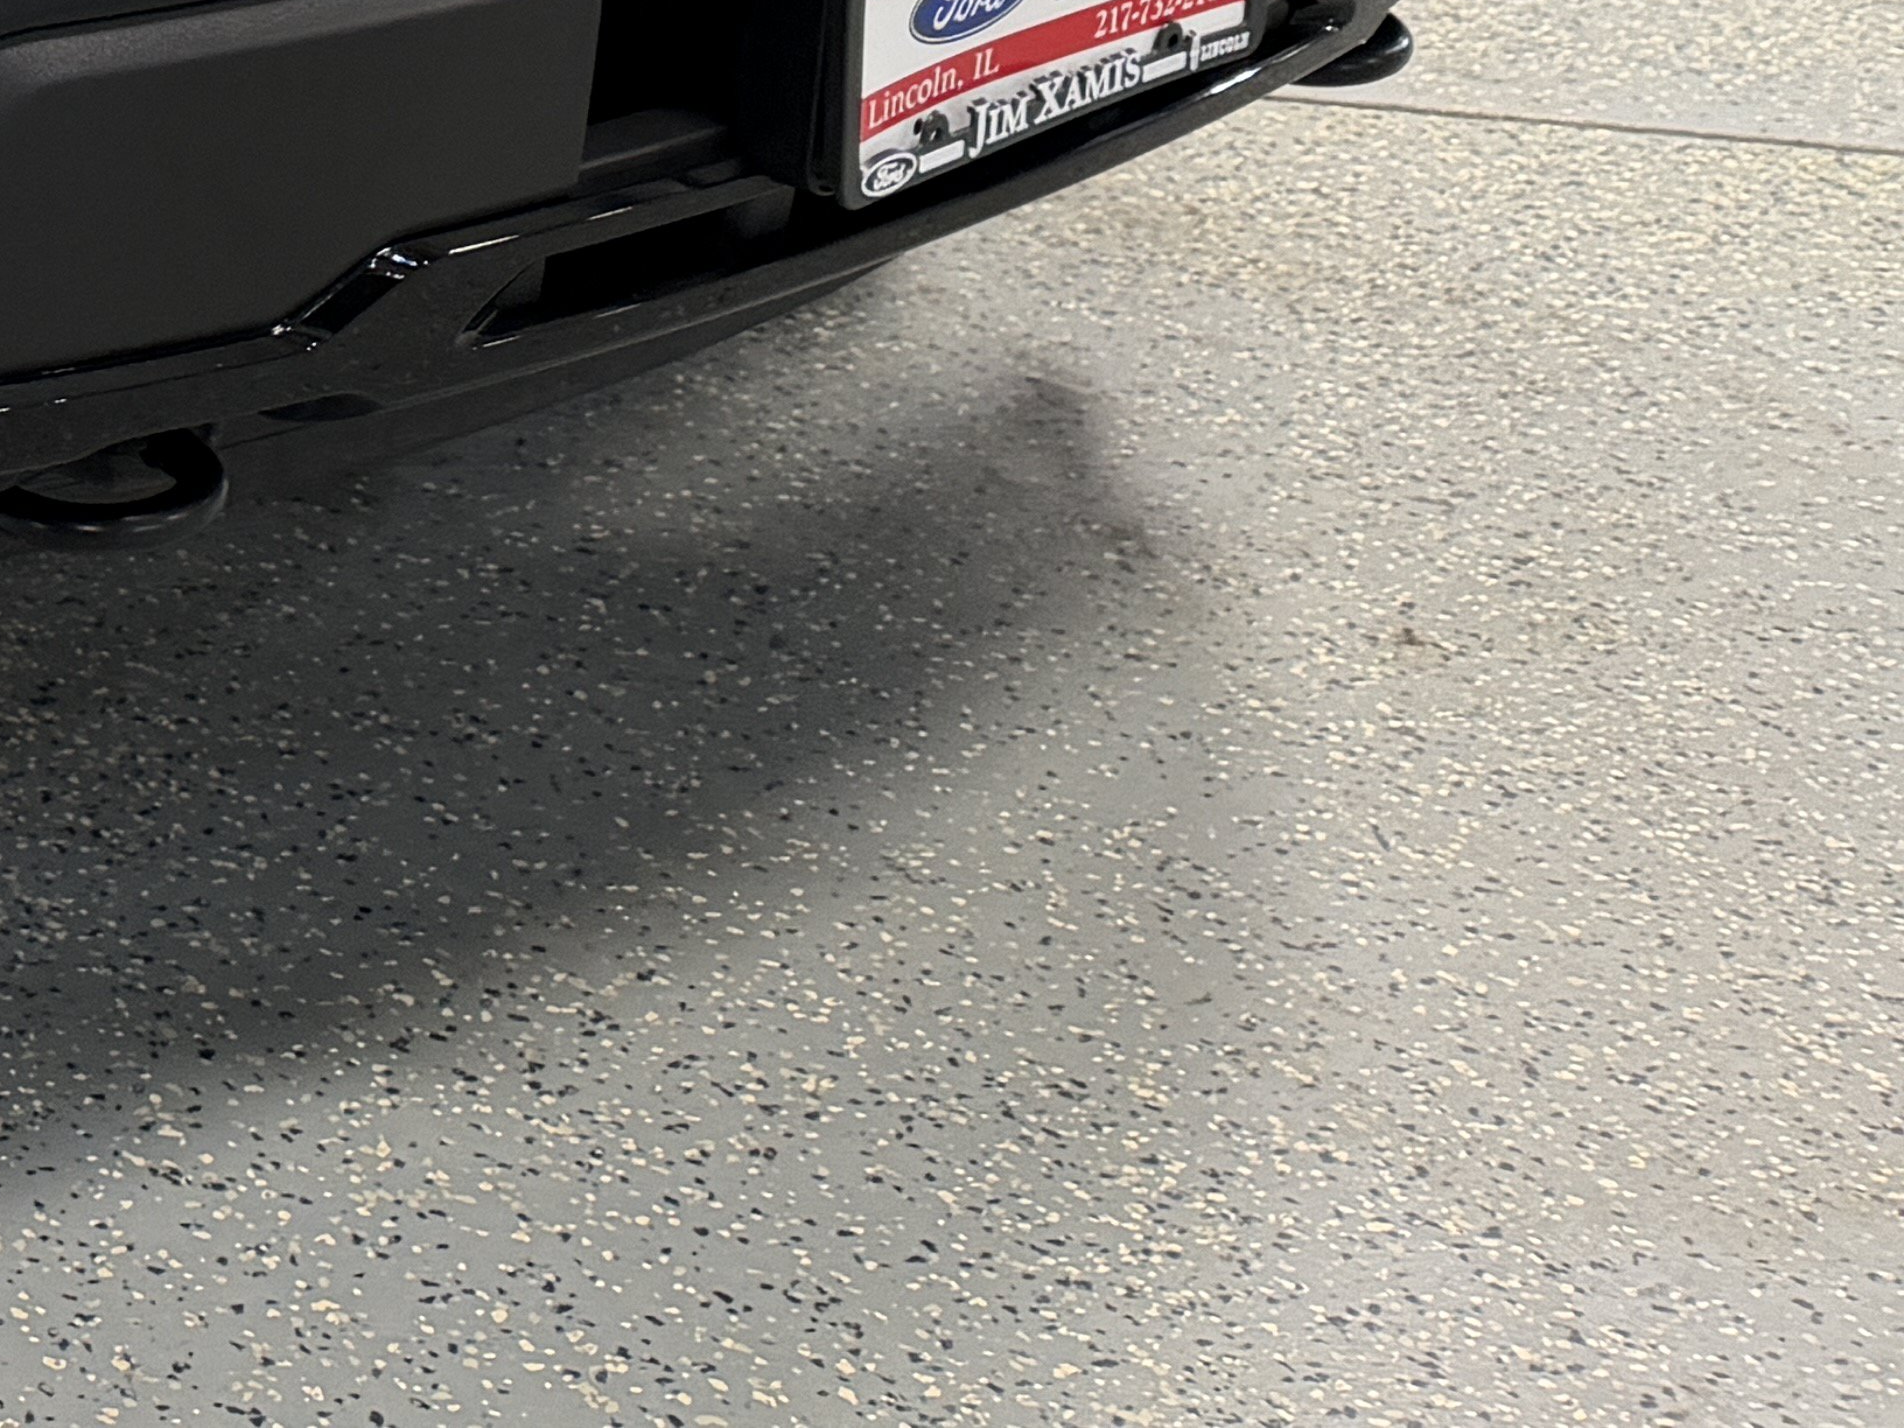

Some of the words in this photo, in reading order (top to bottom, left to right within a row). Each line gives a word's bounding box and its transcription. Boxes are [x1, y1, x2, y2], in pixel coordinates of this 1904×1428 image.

[867, 65, 965, 130] Lincoln,
[972, 46, 1001, 82] IL
[967, 97, 1032, 160] JIM
[1033, 53, 1144, 125] XAMIS
